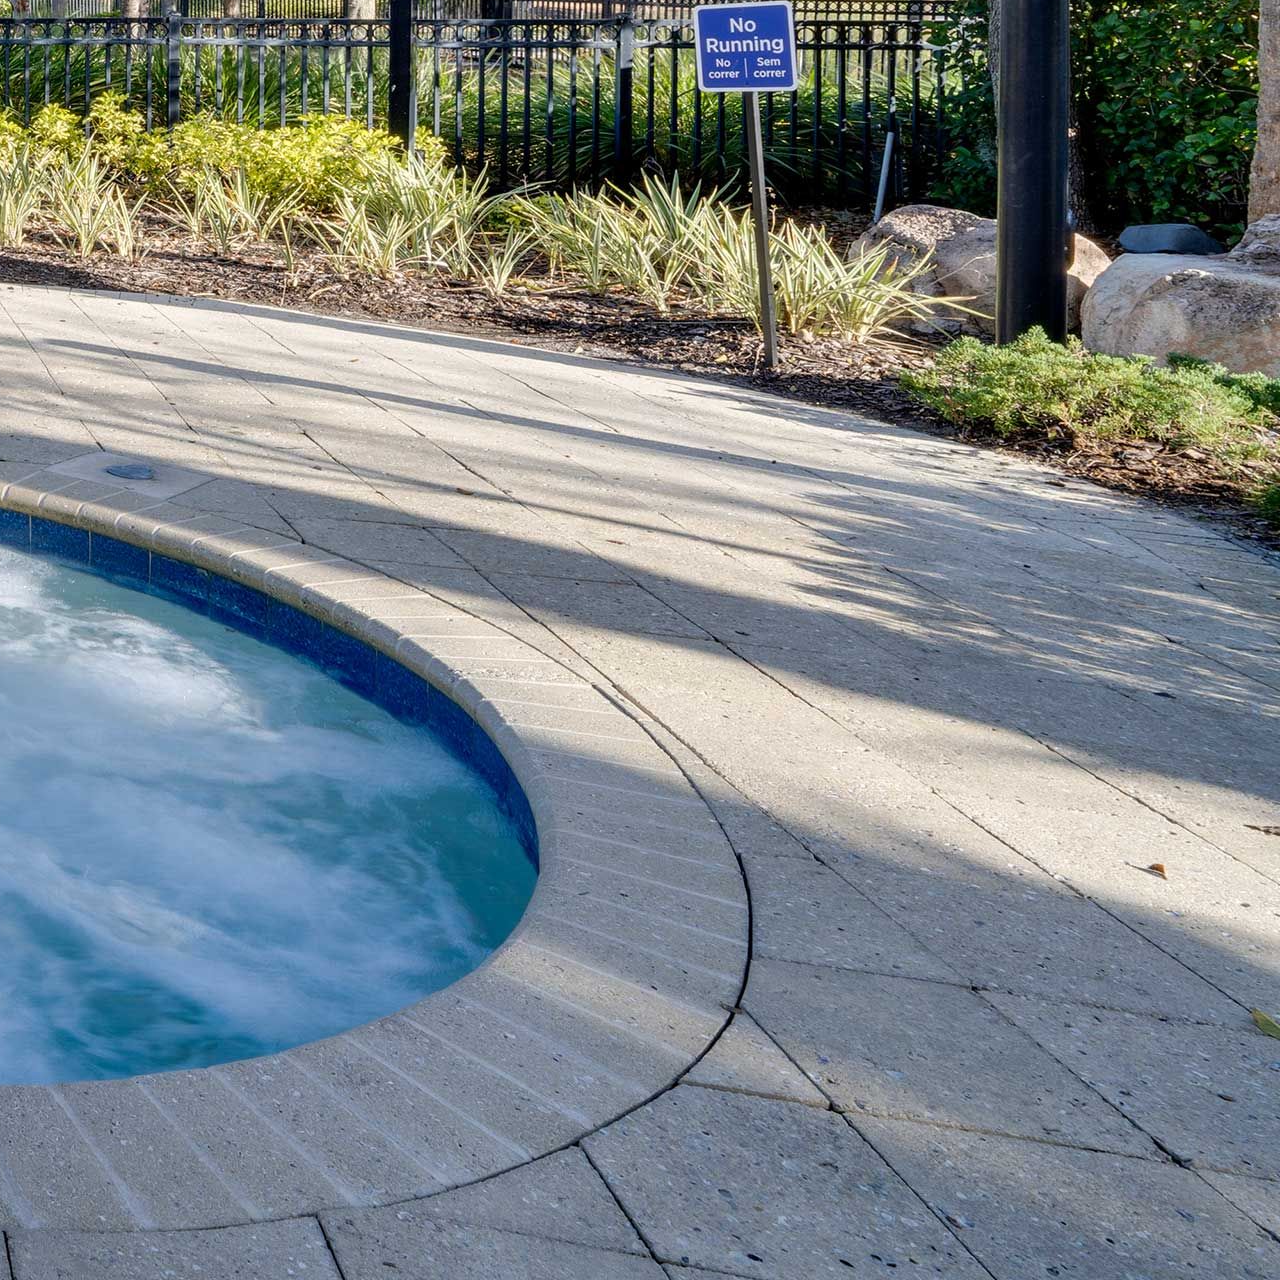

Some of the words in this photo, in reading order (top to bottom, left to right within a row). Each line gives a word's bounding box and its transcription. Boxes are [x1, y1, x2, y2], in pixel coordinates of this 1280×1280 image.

[729, 18, 756, 33] No
[706, 36, 784, 53] Running
[715, 58, 731, 67] No
[757, 57, 781, 66] Sem
[754, 70, 786, 78] correr
